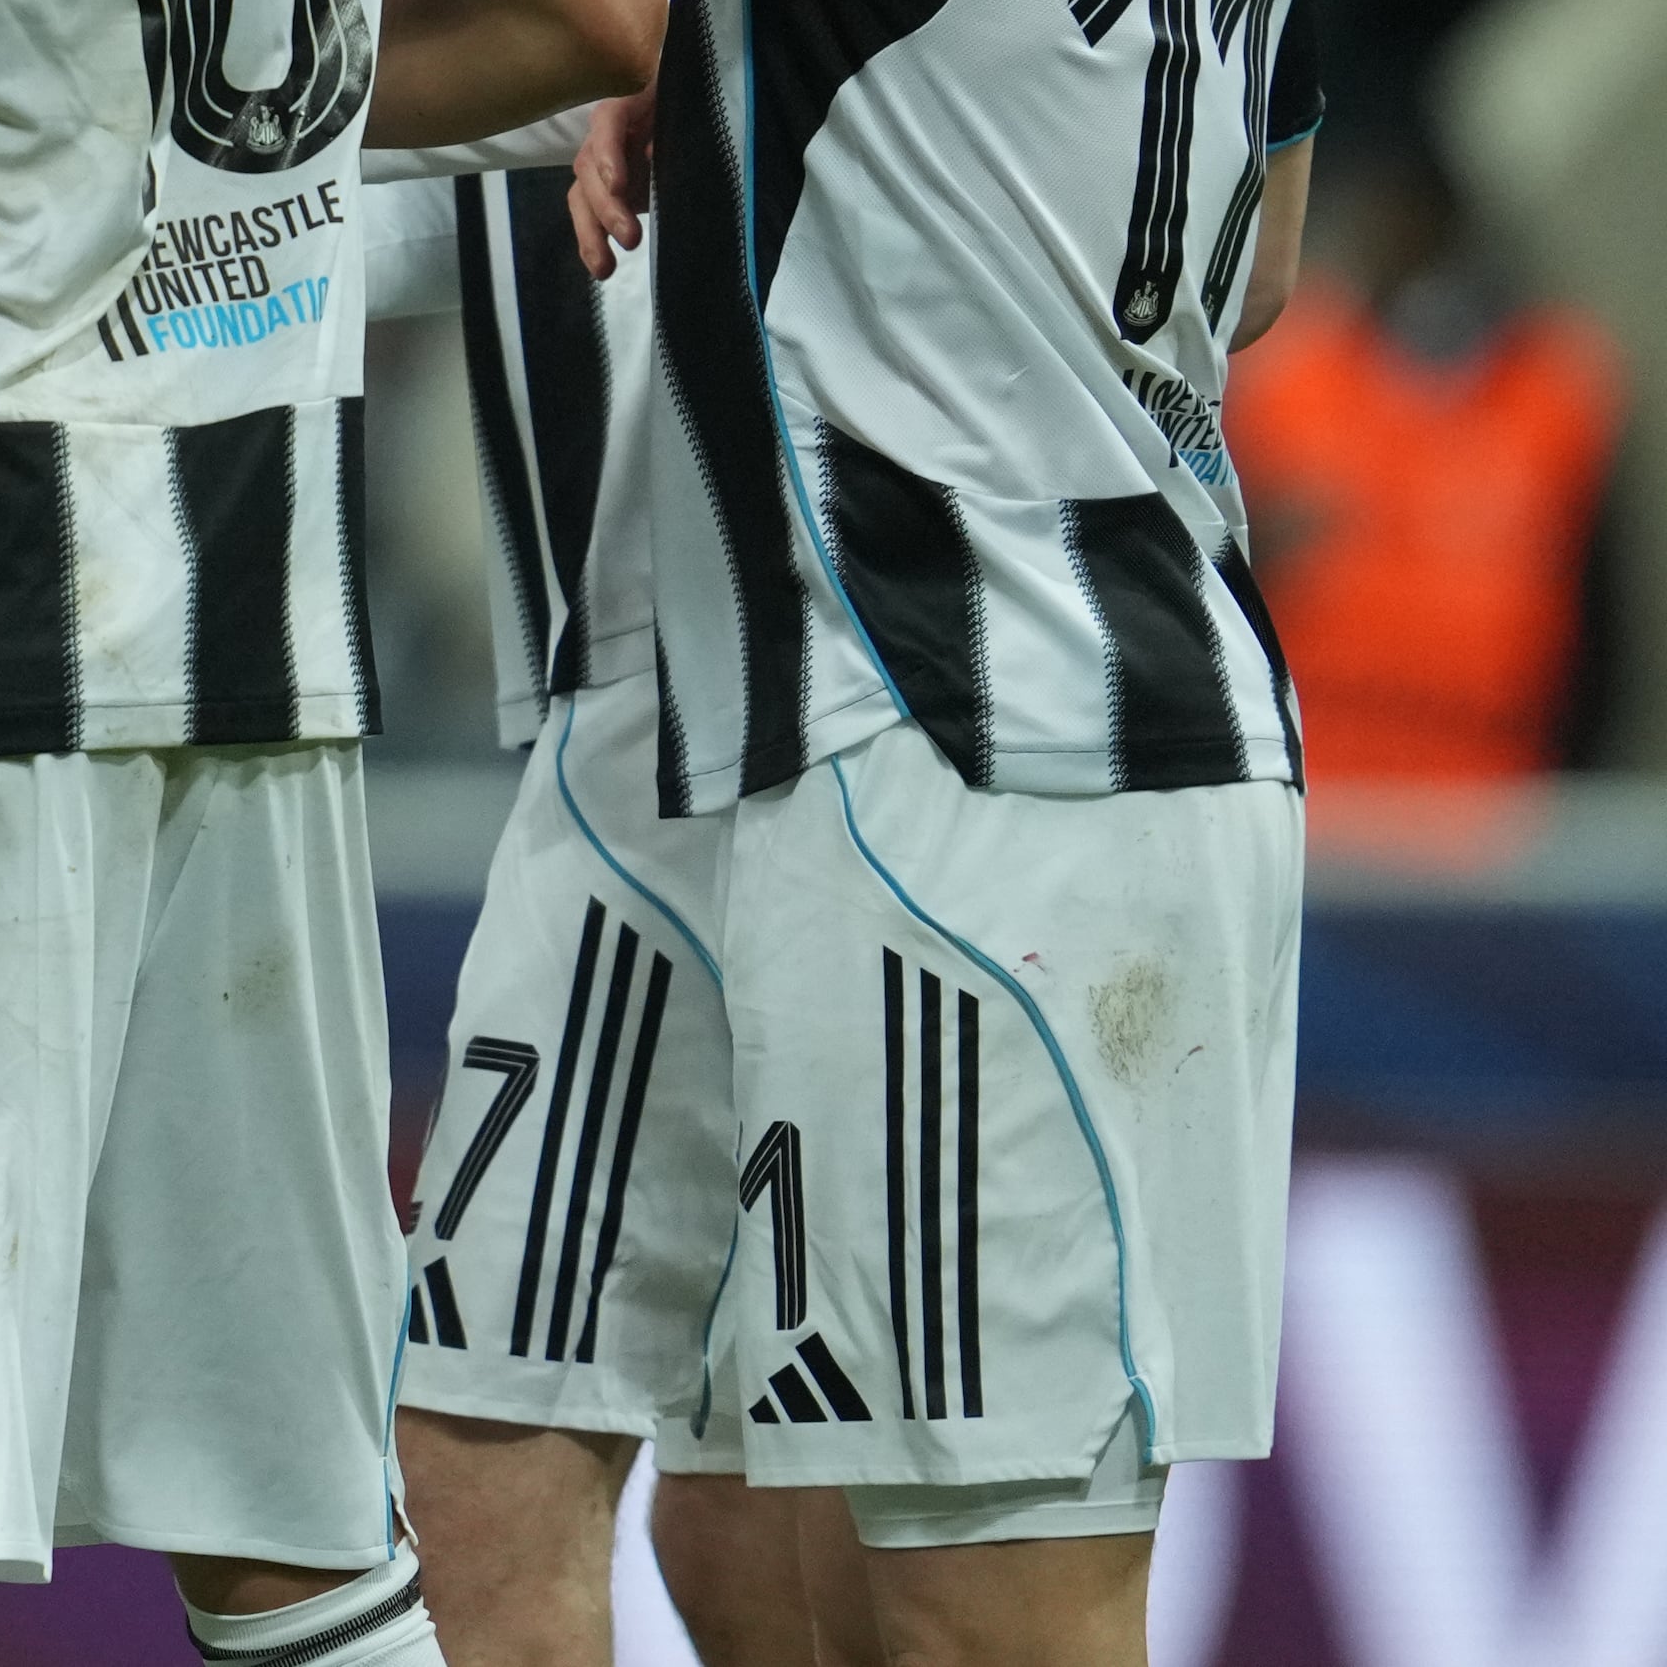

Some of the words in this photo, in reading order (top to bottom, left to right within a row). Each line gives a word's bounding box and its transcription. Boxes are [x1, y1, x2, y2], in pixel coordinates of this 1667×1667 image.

[132, 254, 271, 316] UNITED
[409, 1035, 540, 1241] 7
[737, 1120, 807, 1331] 1
